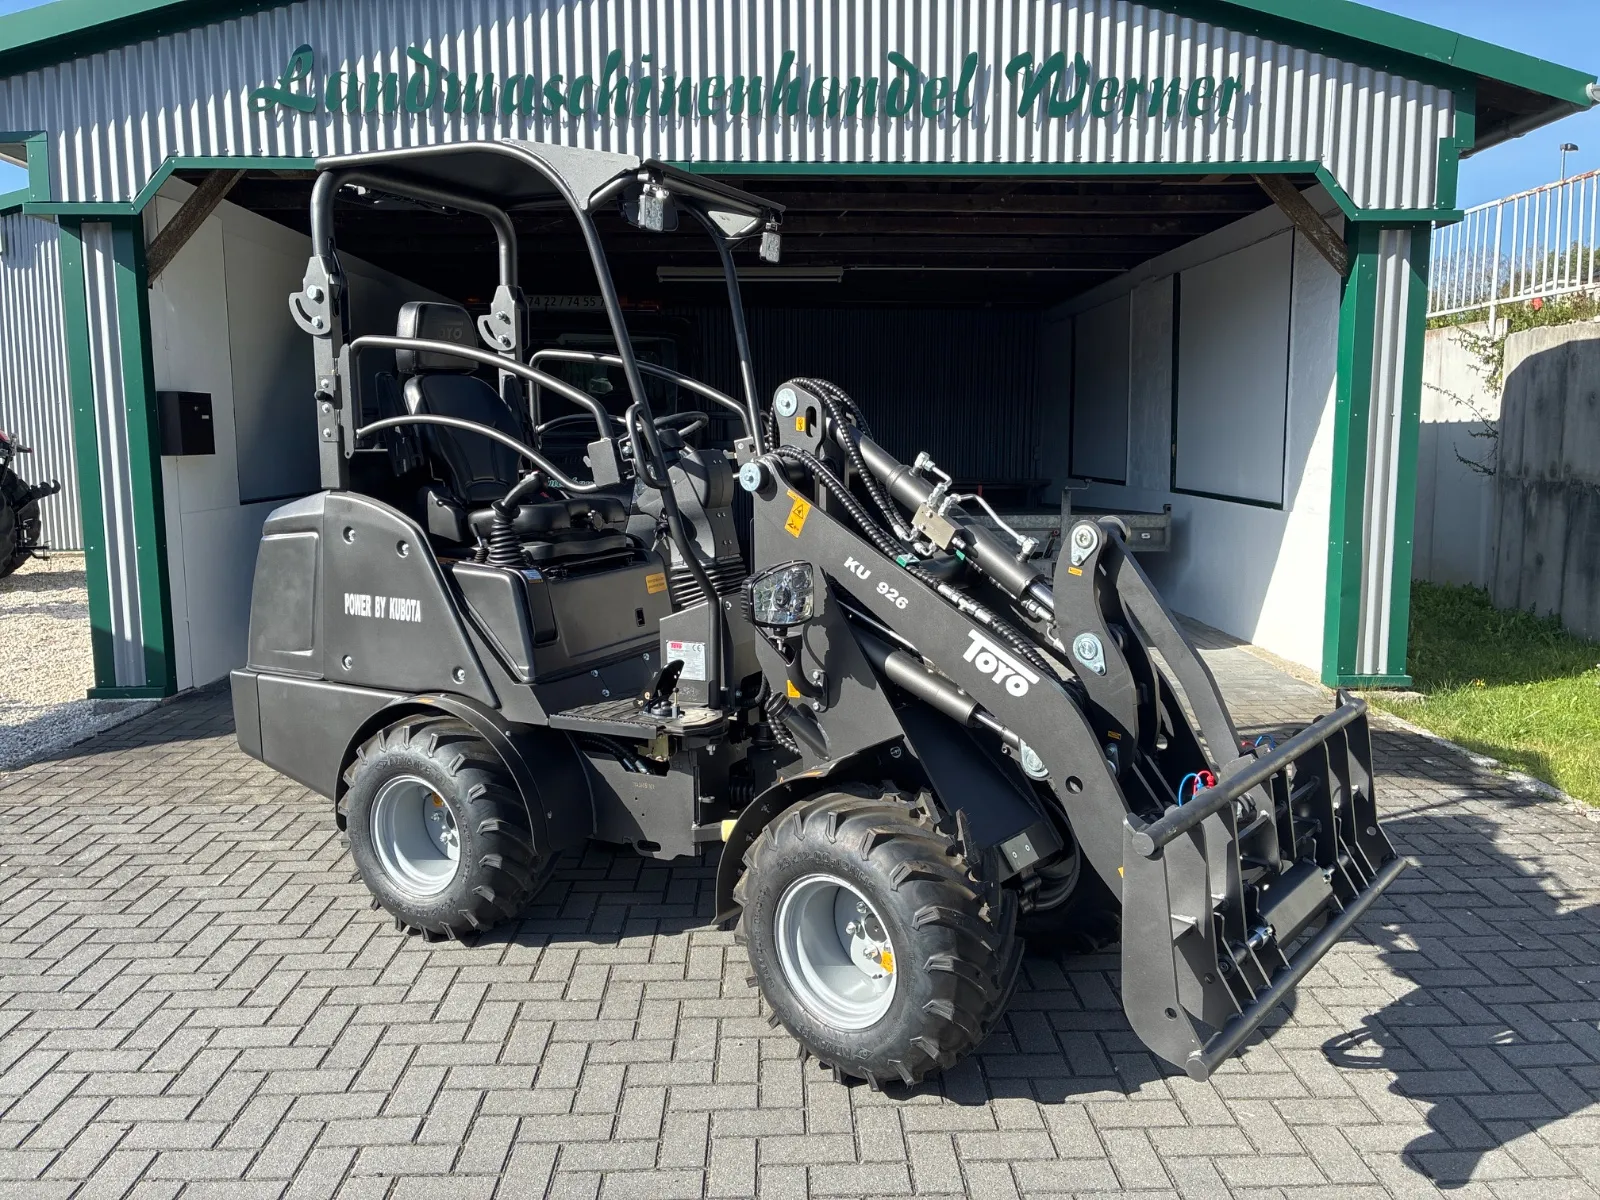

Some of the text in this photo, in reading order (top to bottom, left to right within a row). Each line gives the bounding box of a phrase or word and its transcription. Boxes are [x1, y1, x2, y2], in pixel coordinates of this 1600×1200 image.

[248, 44, 1242, 119] Landmaschinenhandel Werner
[529, 296, 541, 307] 74
[544, 296, 556, 307] 22
[567, 296, 579, 307] 74
[583, 296, 596, 307] 55
[344, 592, 422, 623] POWER BY KUBOTA
[843, 556, 909, 610] KU 926
[962, 629, 1040, 697] TOYO
